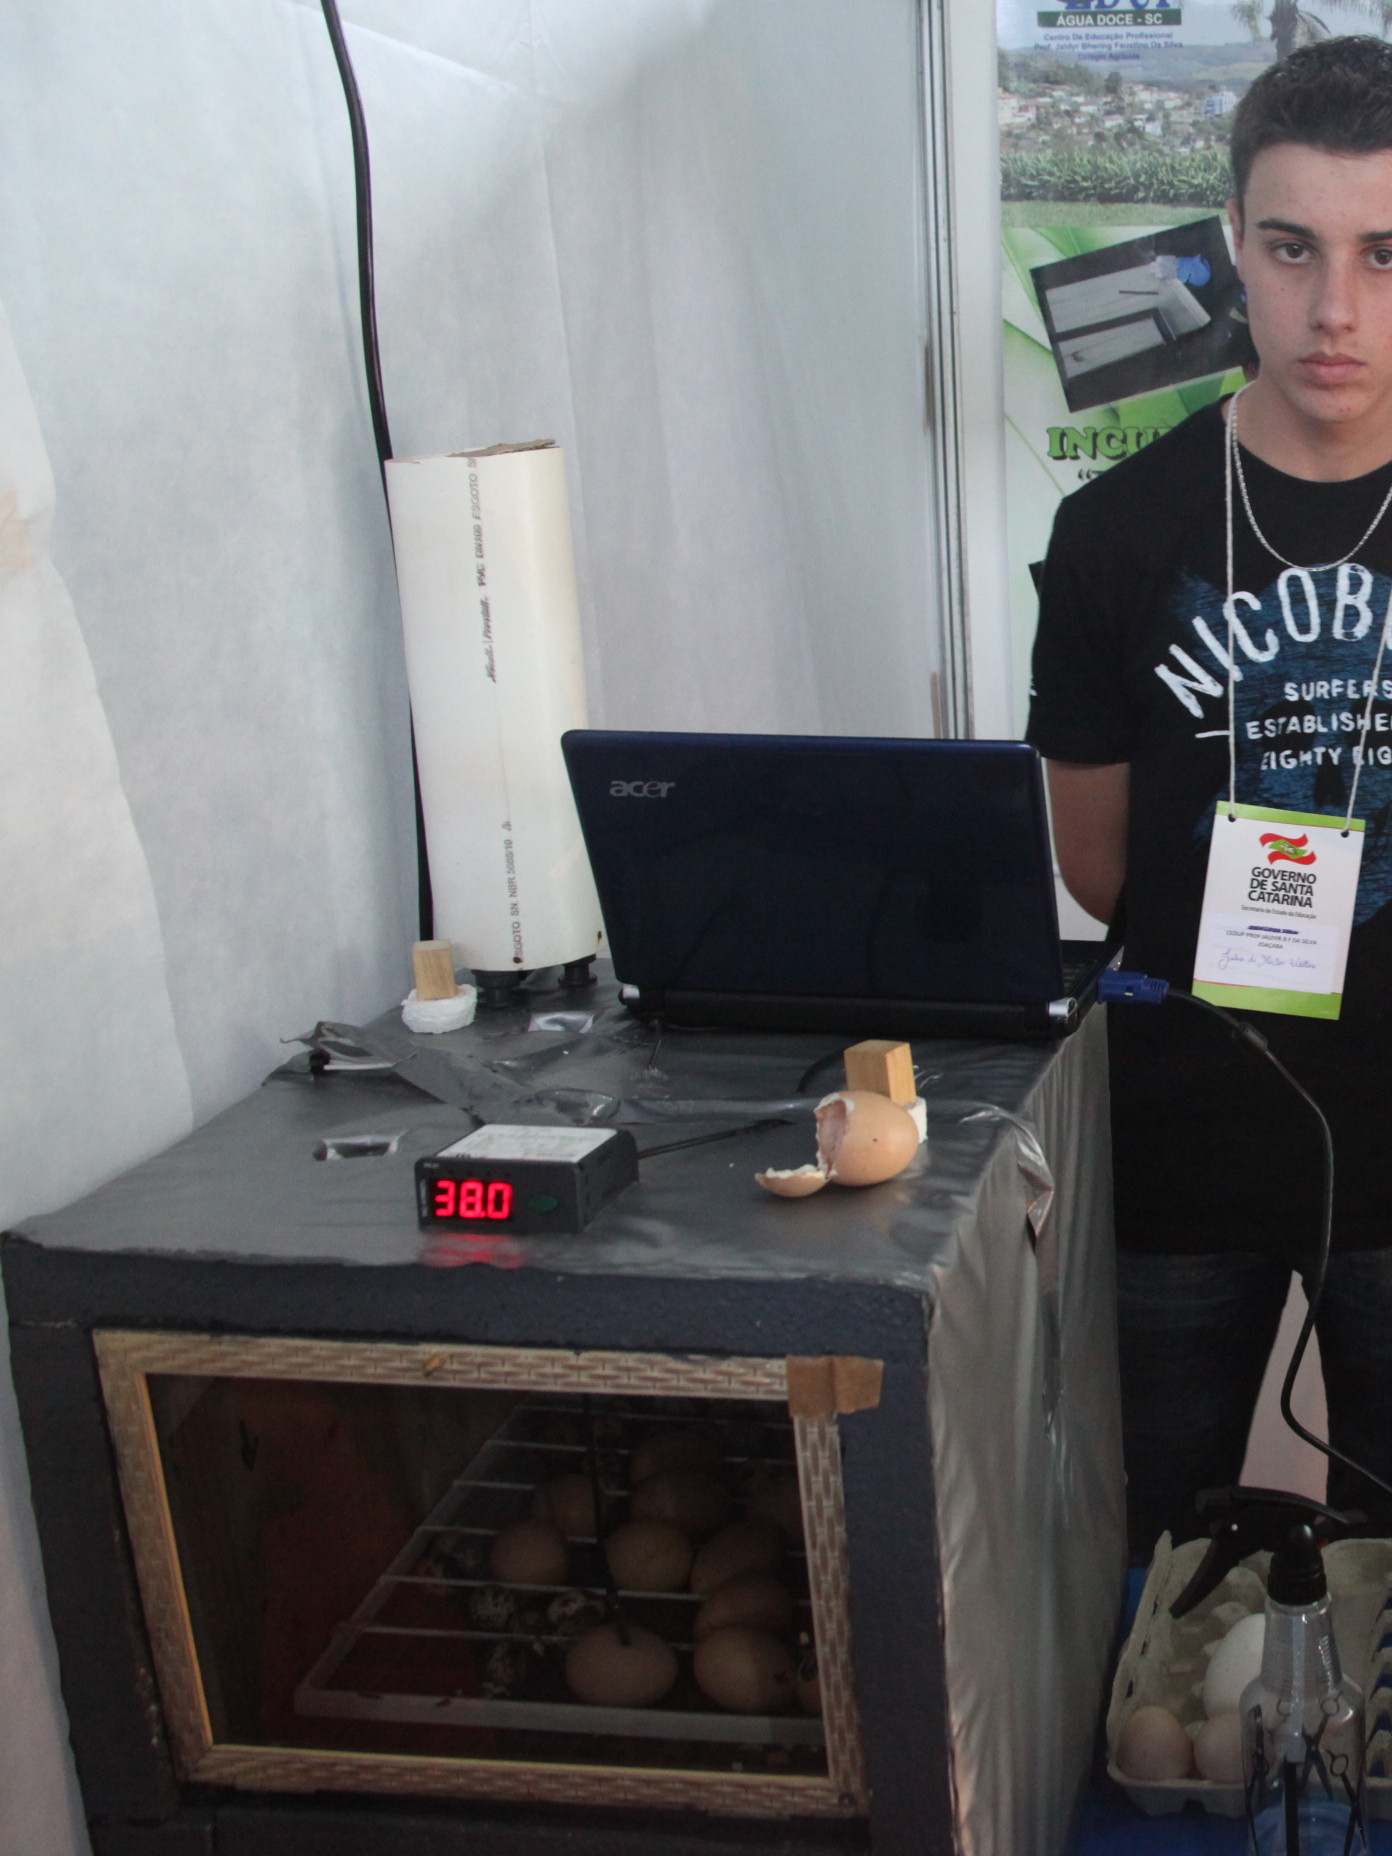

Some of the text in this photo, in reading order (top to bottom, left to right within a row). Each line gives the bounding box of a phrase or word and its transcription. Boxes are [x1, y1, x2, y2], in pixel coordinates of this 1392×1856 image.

[1057, 13, 1094, 26] ÁGUA
[1097, 14, 1133, 26] DOCE
[1145, 13, 1163, 25] SC
[1043, 33, 1070, 41] Centro
[1085, 32, 1123, 41] Educação
[1164, 41, 1183, 49] Silva
[468, 473, 481, 520] ESGOTO
[1260, 746, 1343, 771] EIGHTY
[609, 780, 676, 798] acer
[1251, 866, 1317, 885] GOVERNO
[508, 877, 518, 898] NBR
[1250, 878, 1314, 896] DE SANTA
[1248, 890, 1313, 909] CATARINA
[510, 903, 519, 917] SN
[434, 1179, 513, 1220] 38.0
